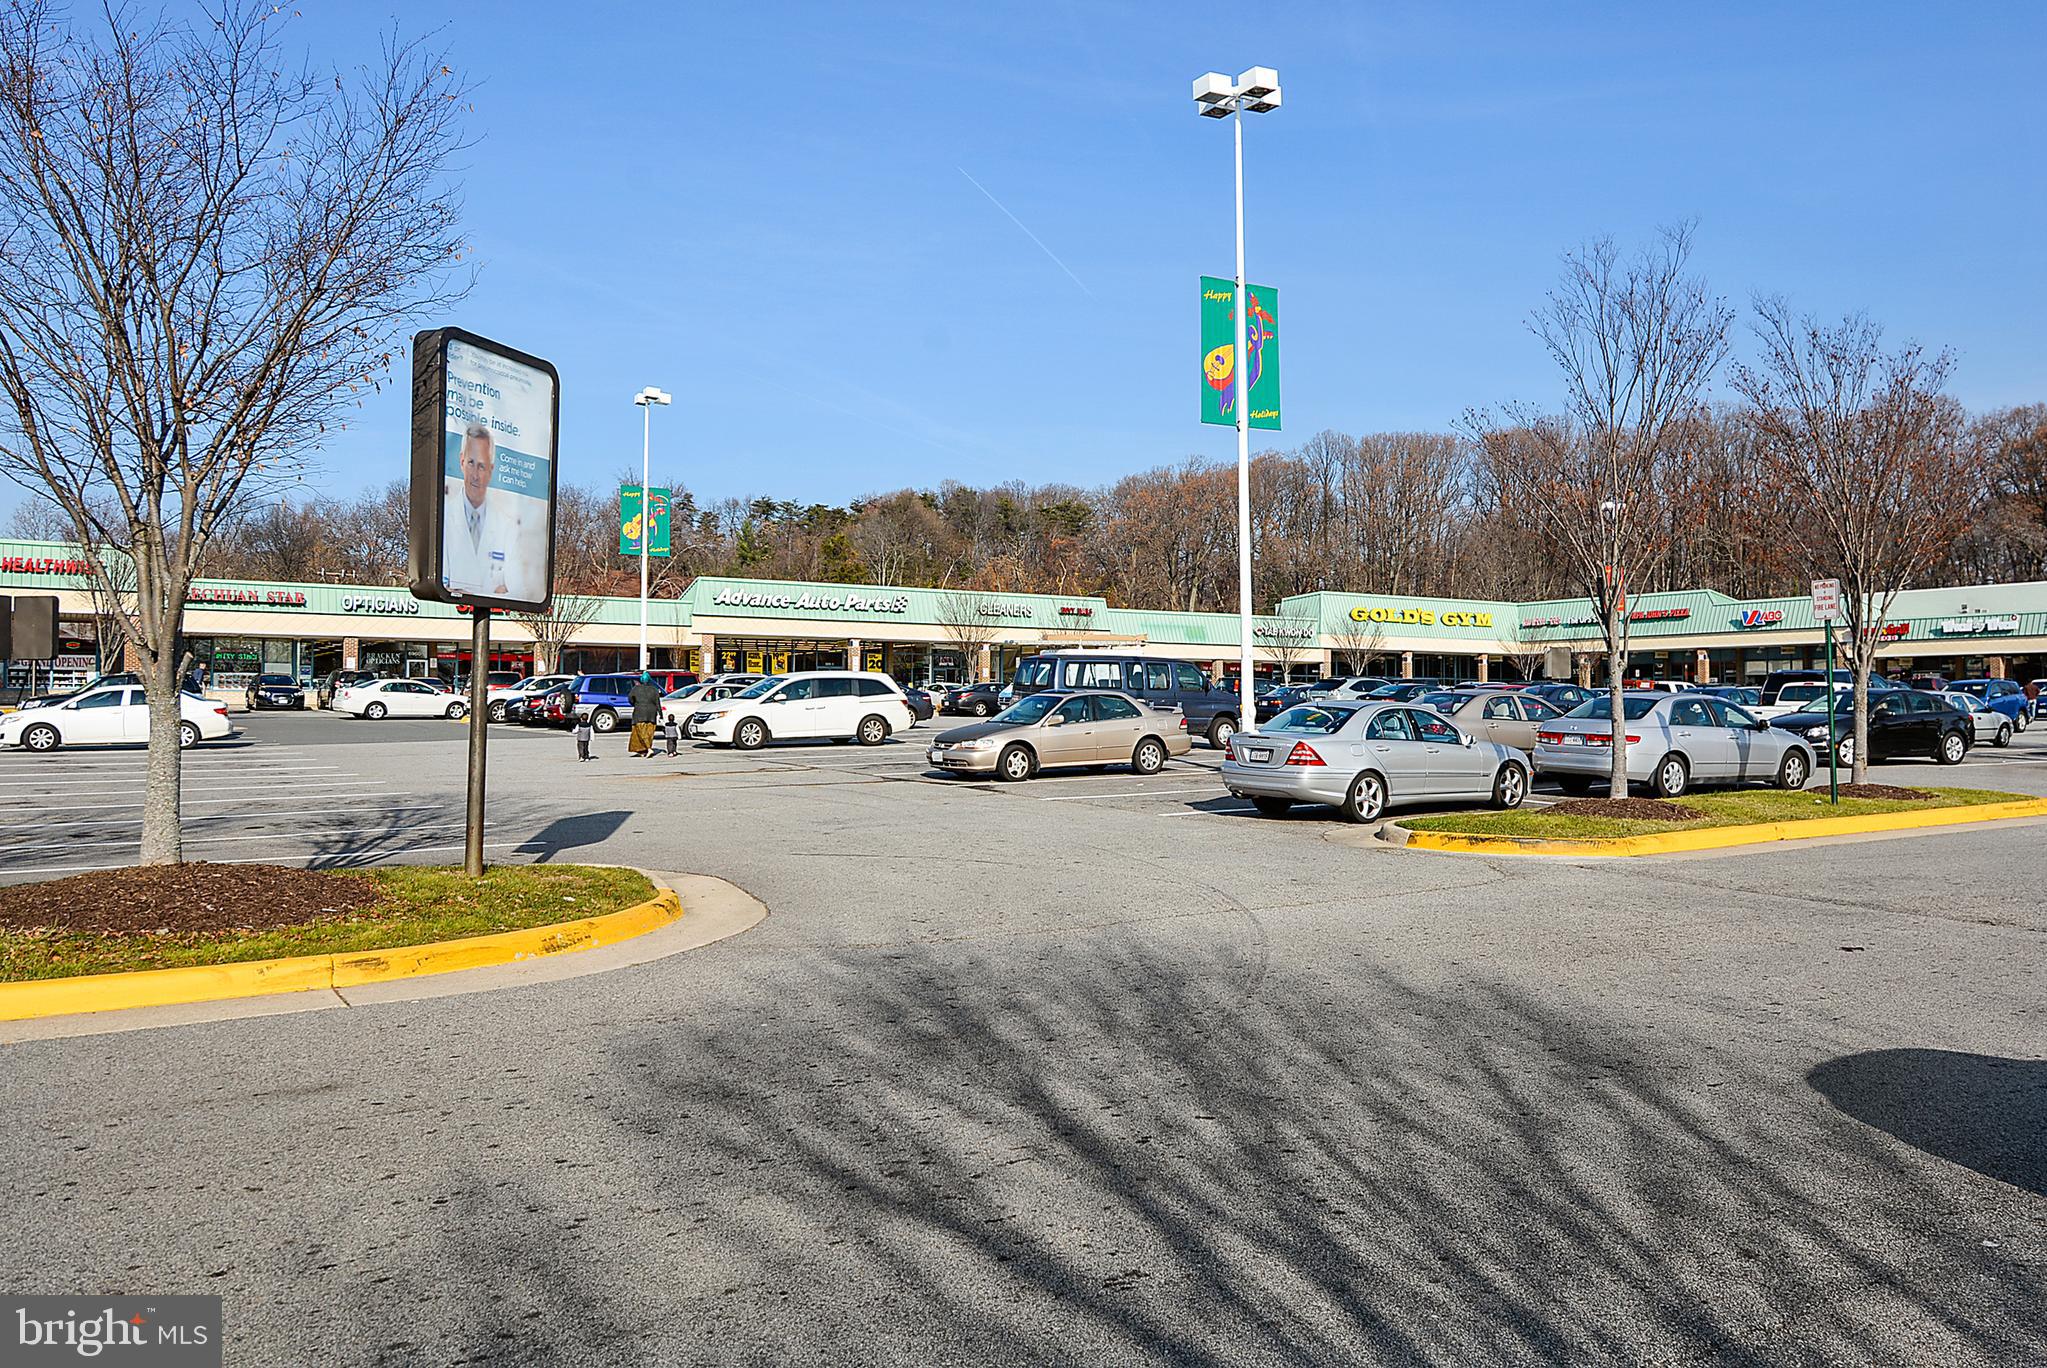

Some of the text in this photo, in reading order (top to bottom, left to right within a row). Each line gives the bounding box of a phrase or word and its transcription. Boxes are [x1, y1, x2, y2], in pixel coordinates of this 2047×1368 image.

[1203, 289, 1232, 302] Happy
[447, 370, 501, 400] Prevention
[447, 388, 484, 410] may be
[446, 405, 520, 437] possible inside.
[1250, 410, 1278, 419] Holidays
[266, 591, 306, 604] STAR
[341, 595, 418, 612] OPTICIANS
[714, 588, 892, 612] Advance Auto Parts
[979, 602, 1033, 617] CLEANERS
[1351, 607, 1492, 627] GOLD'S GYM
[1761, 610, 1782, 621] ABC
[54, 656, 96, 668] OPENING
